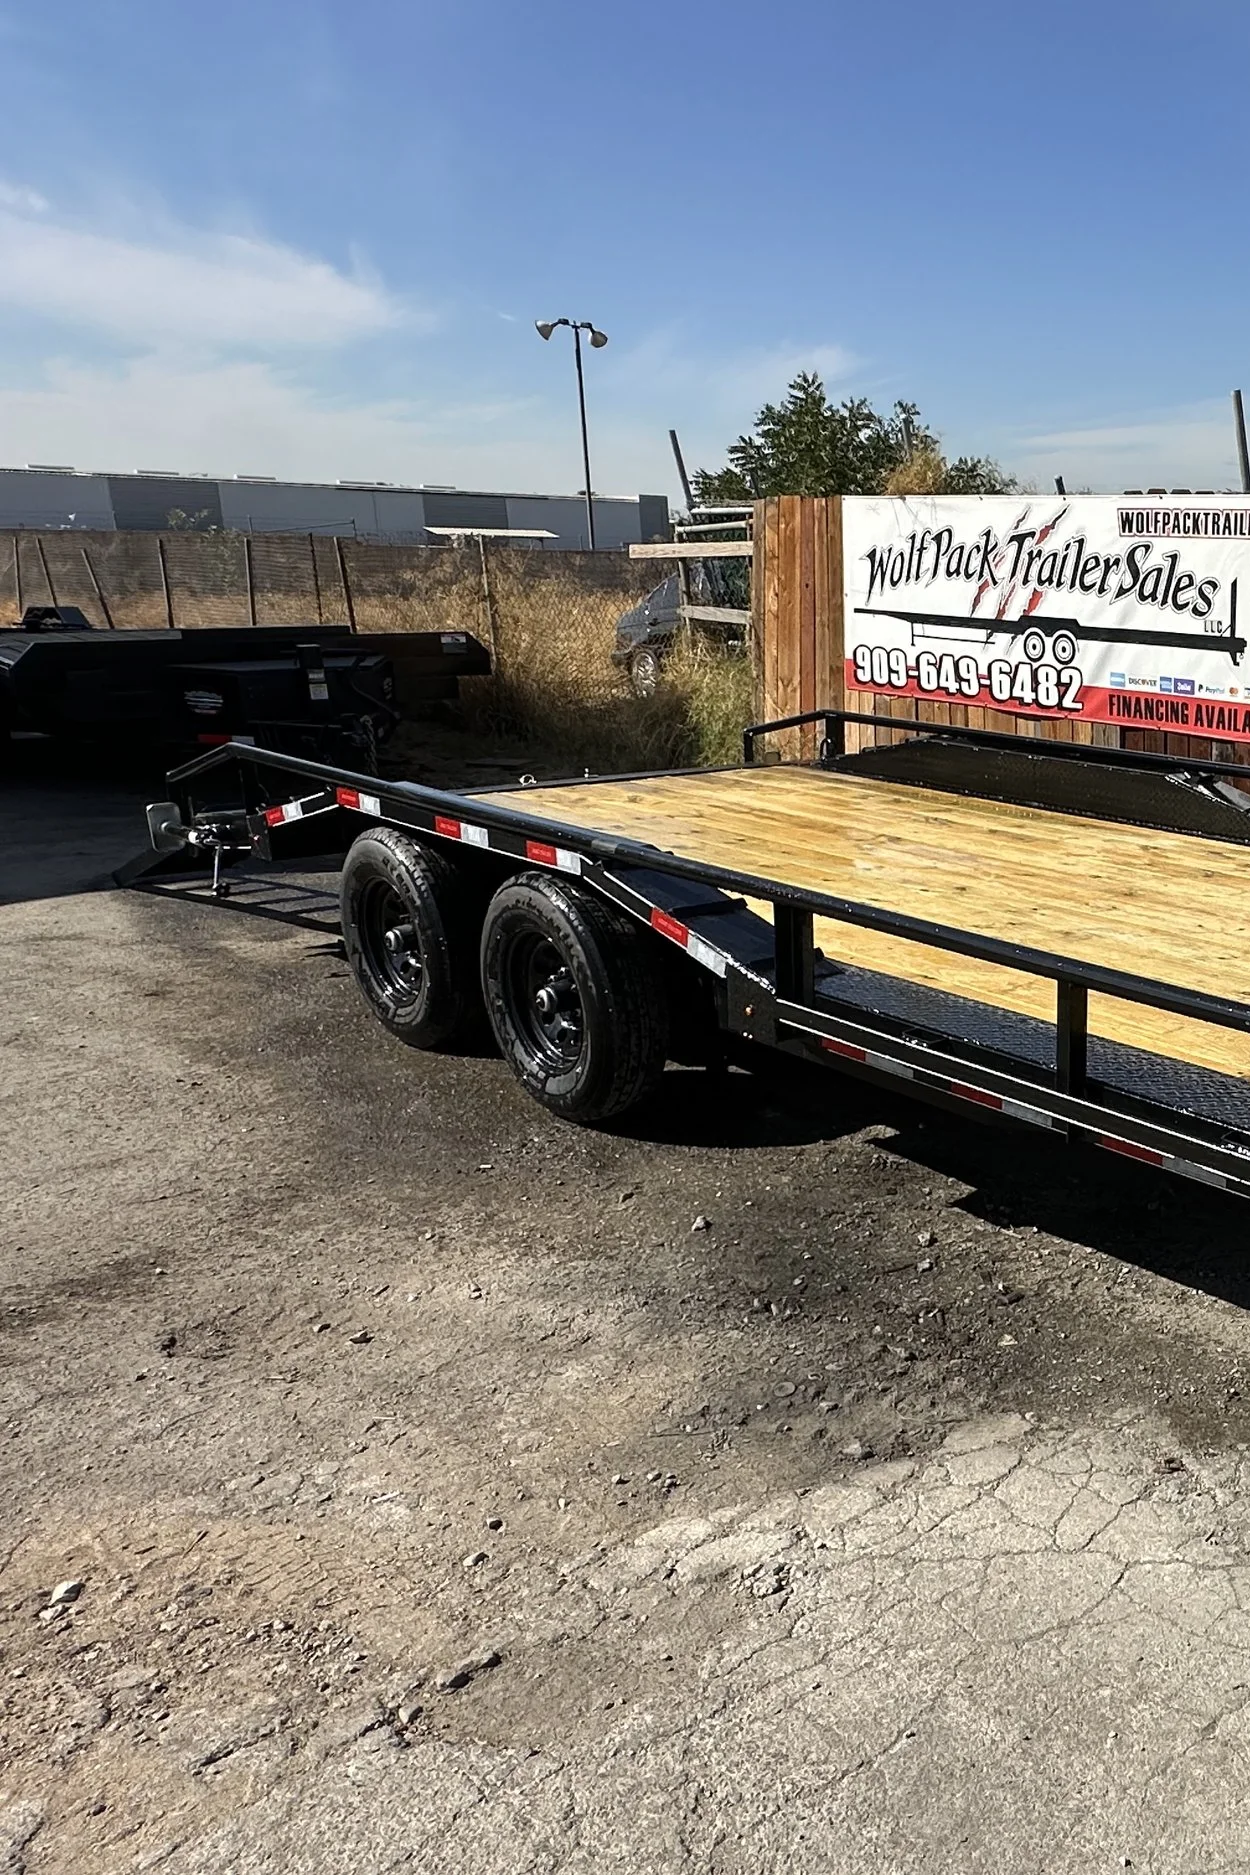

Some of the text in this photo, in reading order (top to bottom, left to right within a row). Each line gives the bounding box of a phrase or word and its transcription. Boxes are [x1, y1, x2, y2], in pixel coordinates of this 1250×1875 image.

[1203, 619, 1223, 634] LLC
[854, 645, 1083, 711] 909-649-6482
[1108, 693, 1189, 725] FINANCING
